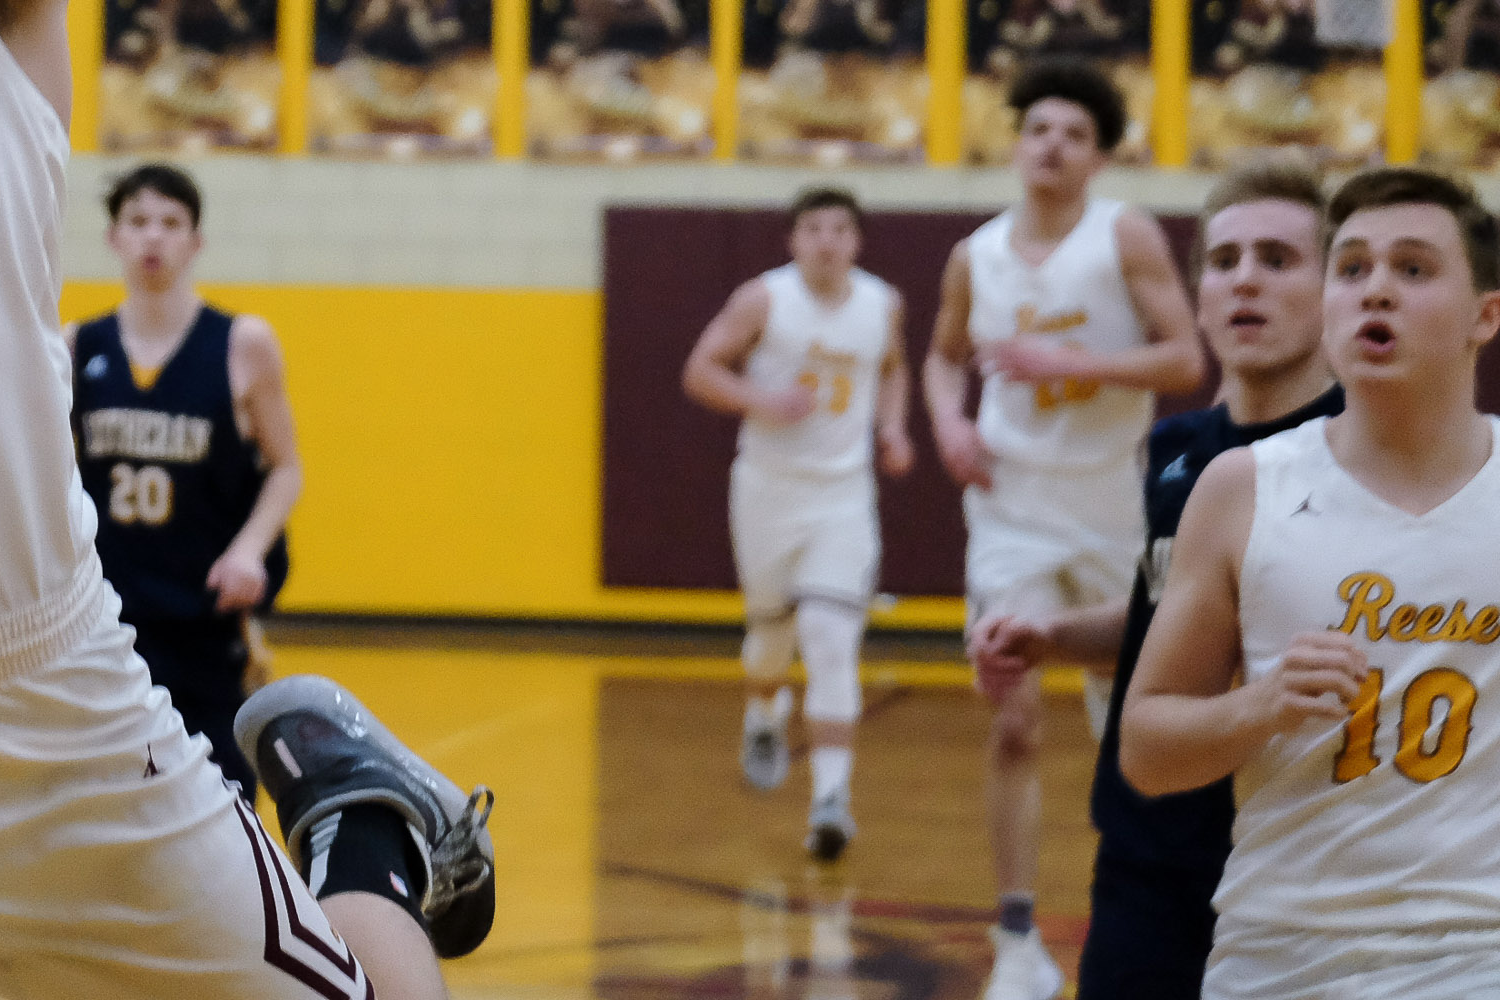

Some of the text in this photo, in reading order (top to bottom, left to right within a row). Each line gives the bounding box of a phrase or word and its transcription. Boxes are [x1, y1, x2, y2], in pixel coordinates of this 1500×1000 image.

[109, 463, 174, 526] 20
[1328, 571, 1500, 645] Reese
[1332, 667, 1478, 784] 10
